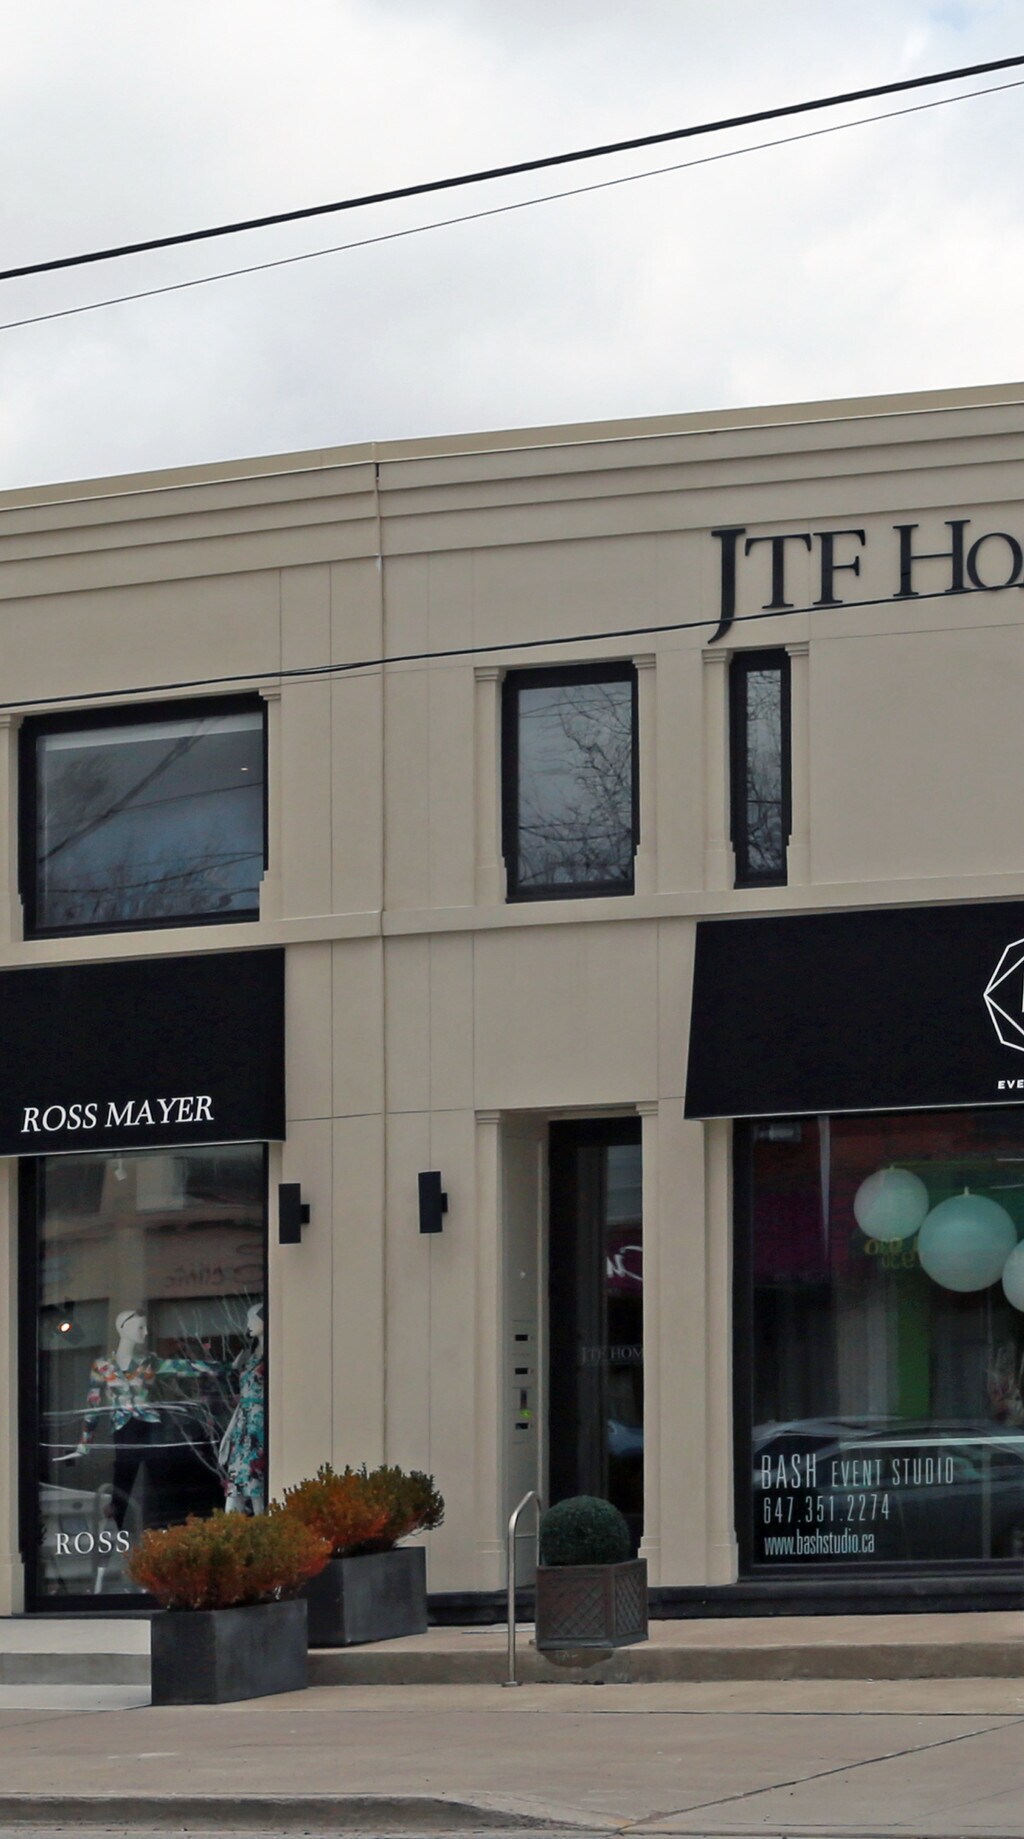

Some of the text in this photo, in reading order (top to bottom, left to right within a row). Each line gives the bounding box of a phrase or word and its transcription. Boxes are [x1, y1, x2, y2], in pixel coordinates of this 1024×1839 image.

[707, 526, 867, 645] JTF
[20, 1095, 215, 1133] ROSS MAYER
[761, 1453, 954, 1490] BASH EVENT STUDIO
[763, 1493, 890, 1524] 647.351.2274
[55, 1530, 131, 1555] ROSS
[764, 1527, 875, 1555] www.bashstudio.ca
